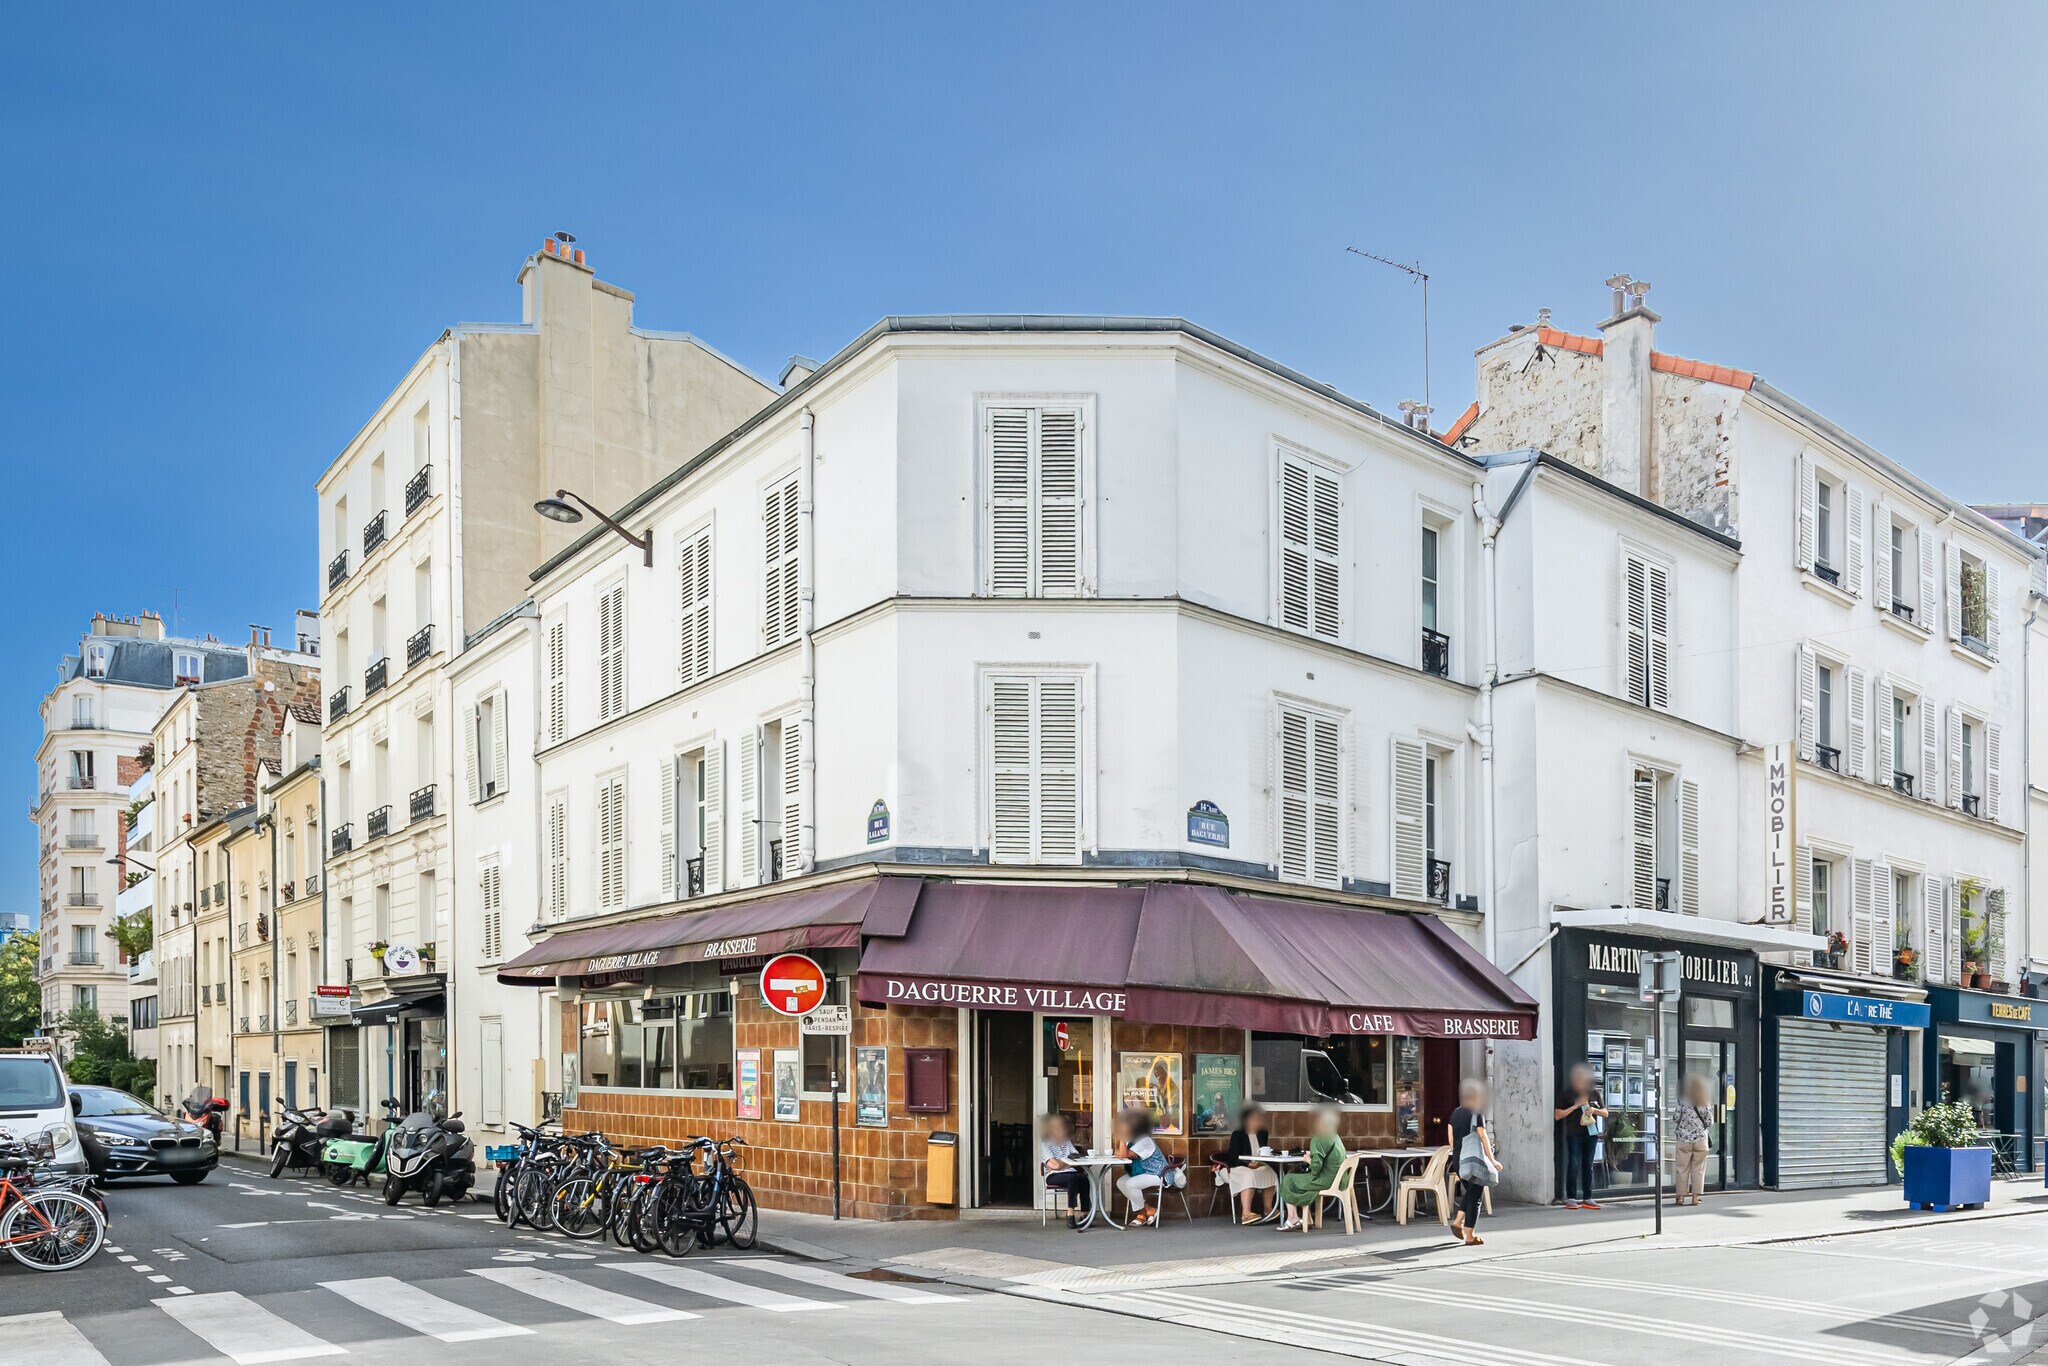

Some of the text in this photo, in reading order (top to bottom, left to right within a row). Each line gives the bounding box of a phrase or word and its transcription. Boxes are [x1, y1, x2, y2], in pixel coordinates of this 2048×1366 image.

[1191, 829, 1226, 842] DAGUERRE
[1201, 822, 1216, 832] RUE
[1770, 744, 1786, 921] IMMOBILIER
[703, 936, 757, 958] BRASSERIE
[587, 950, 660, 972] DAGUERRE VILLAGE
[1588, 943, 1648, 974] MARTIN
[1744, 974, 1752, 987] 34
[886, 979, 1126, 1012] DAGUERRE VILLAGE
[1349, 1013, 1520, 1036] CAFE BRASSERIE
[1201, 1067, 1223, 1076] JAMES
